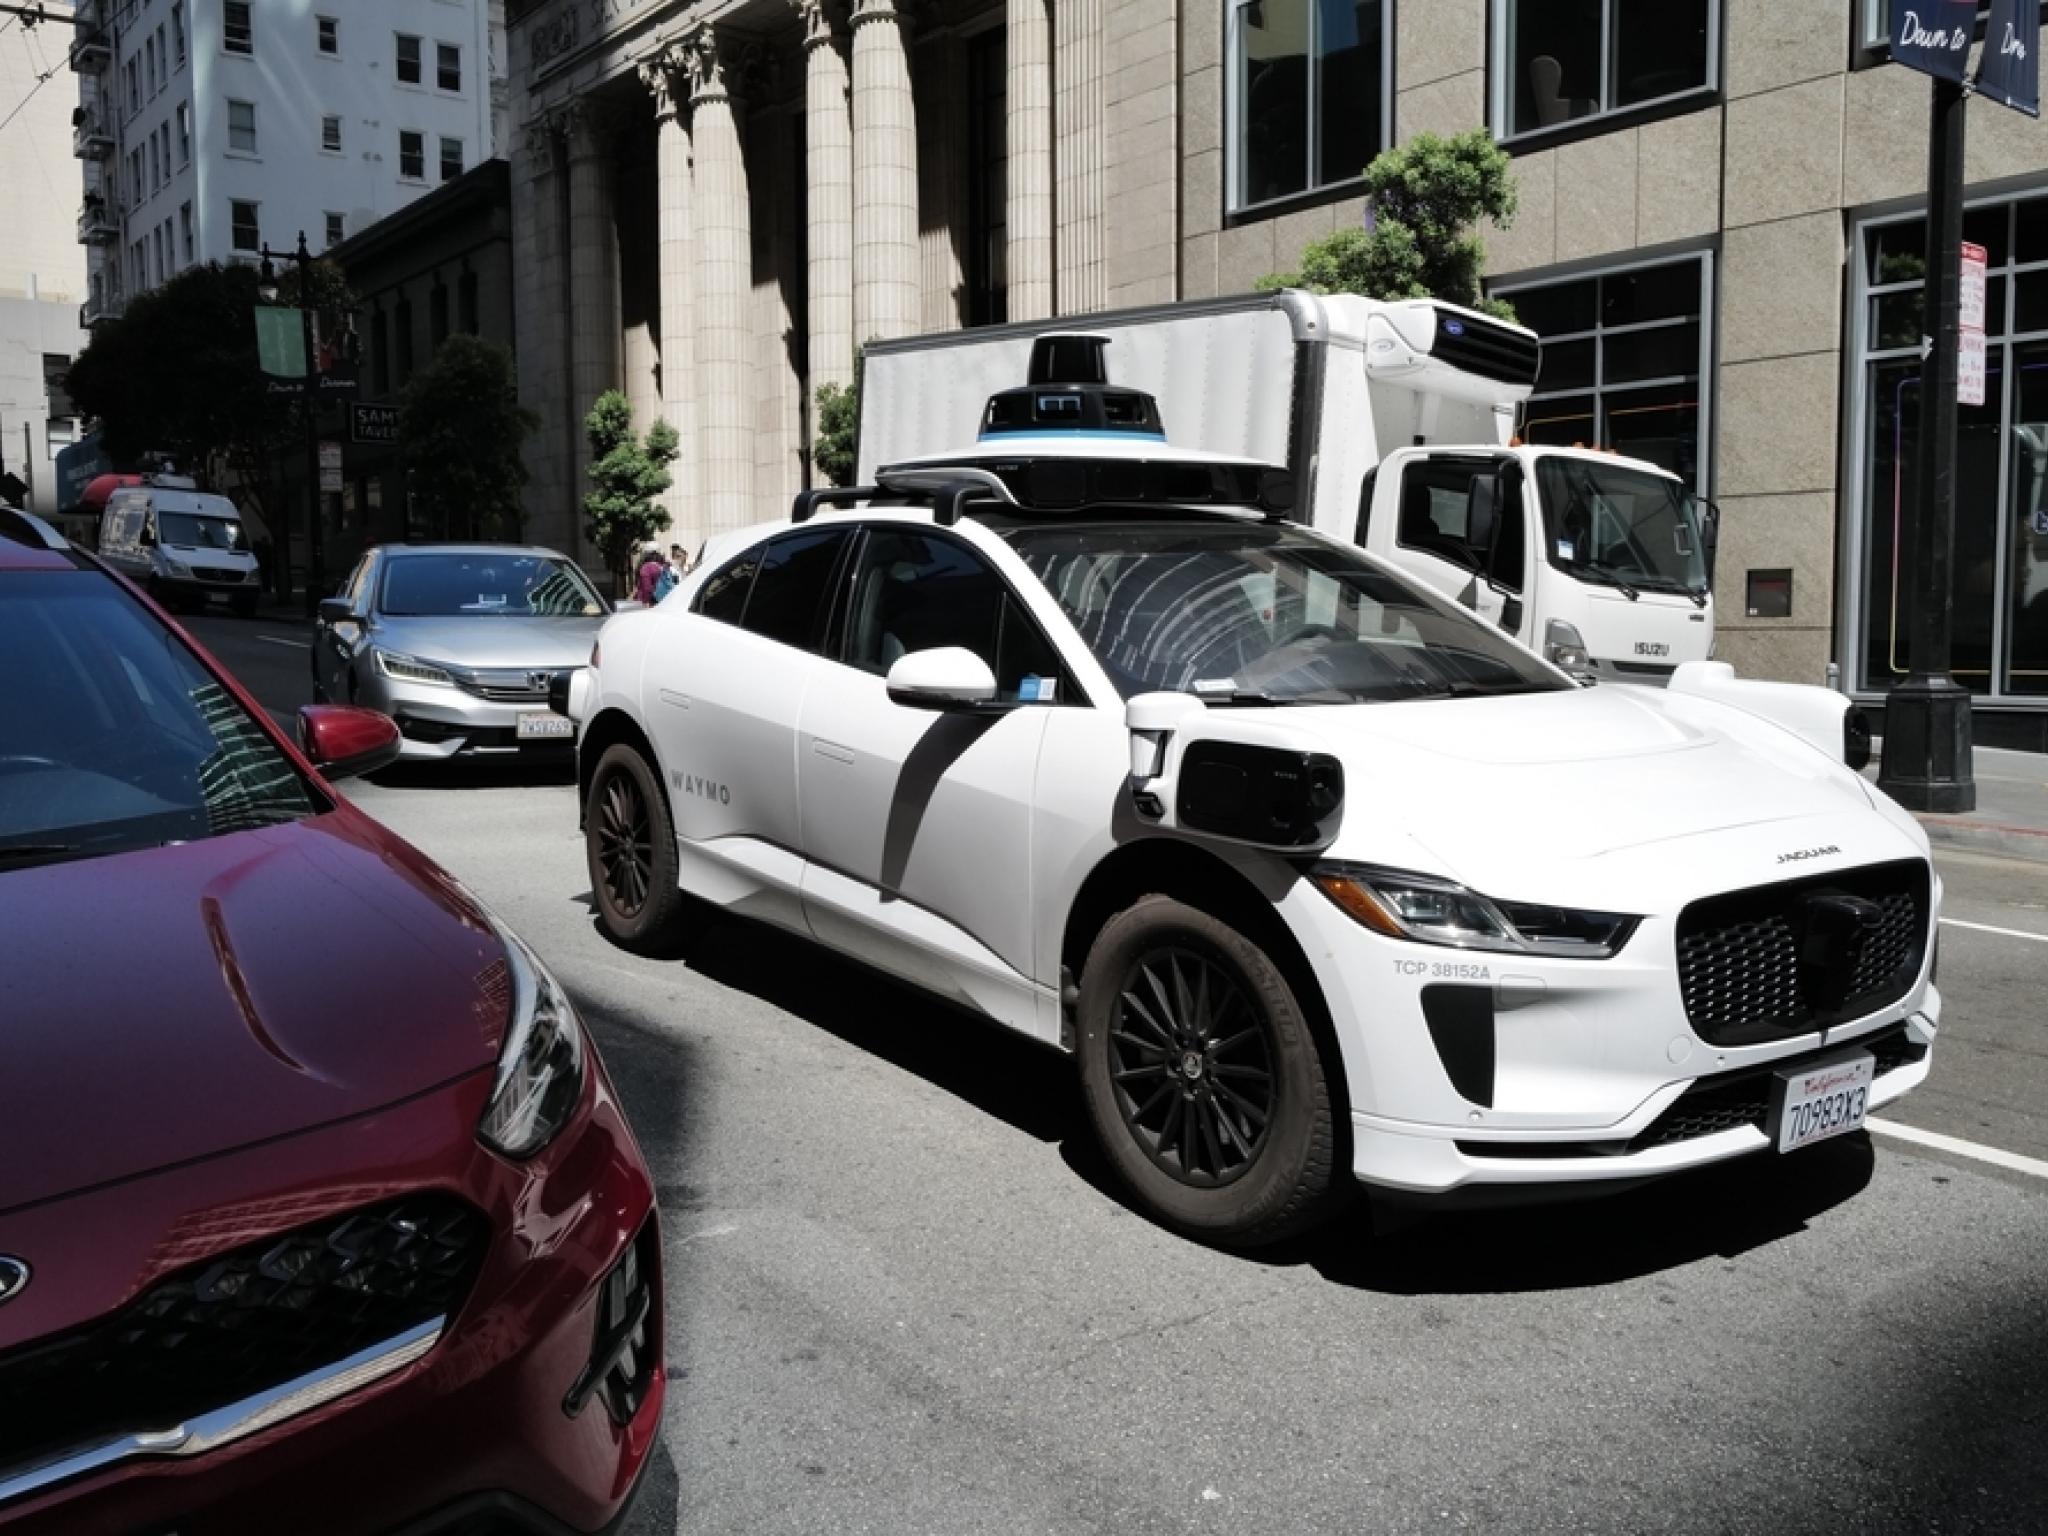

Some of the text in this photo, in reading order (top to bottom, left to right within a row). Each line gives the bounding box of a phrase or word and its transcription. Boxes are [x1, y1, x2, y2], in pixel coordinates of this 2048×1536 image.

[1634, 642, 1670, 657] ISUZU
[671, 769, 731, 806] WAYMO
[1777, 844, 1842, 865] JAGUAR
[1393, 959, 1491, 980] TCP 38152A
[1790, 1086, 1866, 1142] 70983X3
